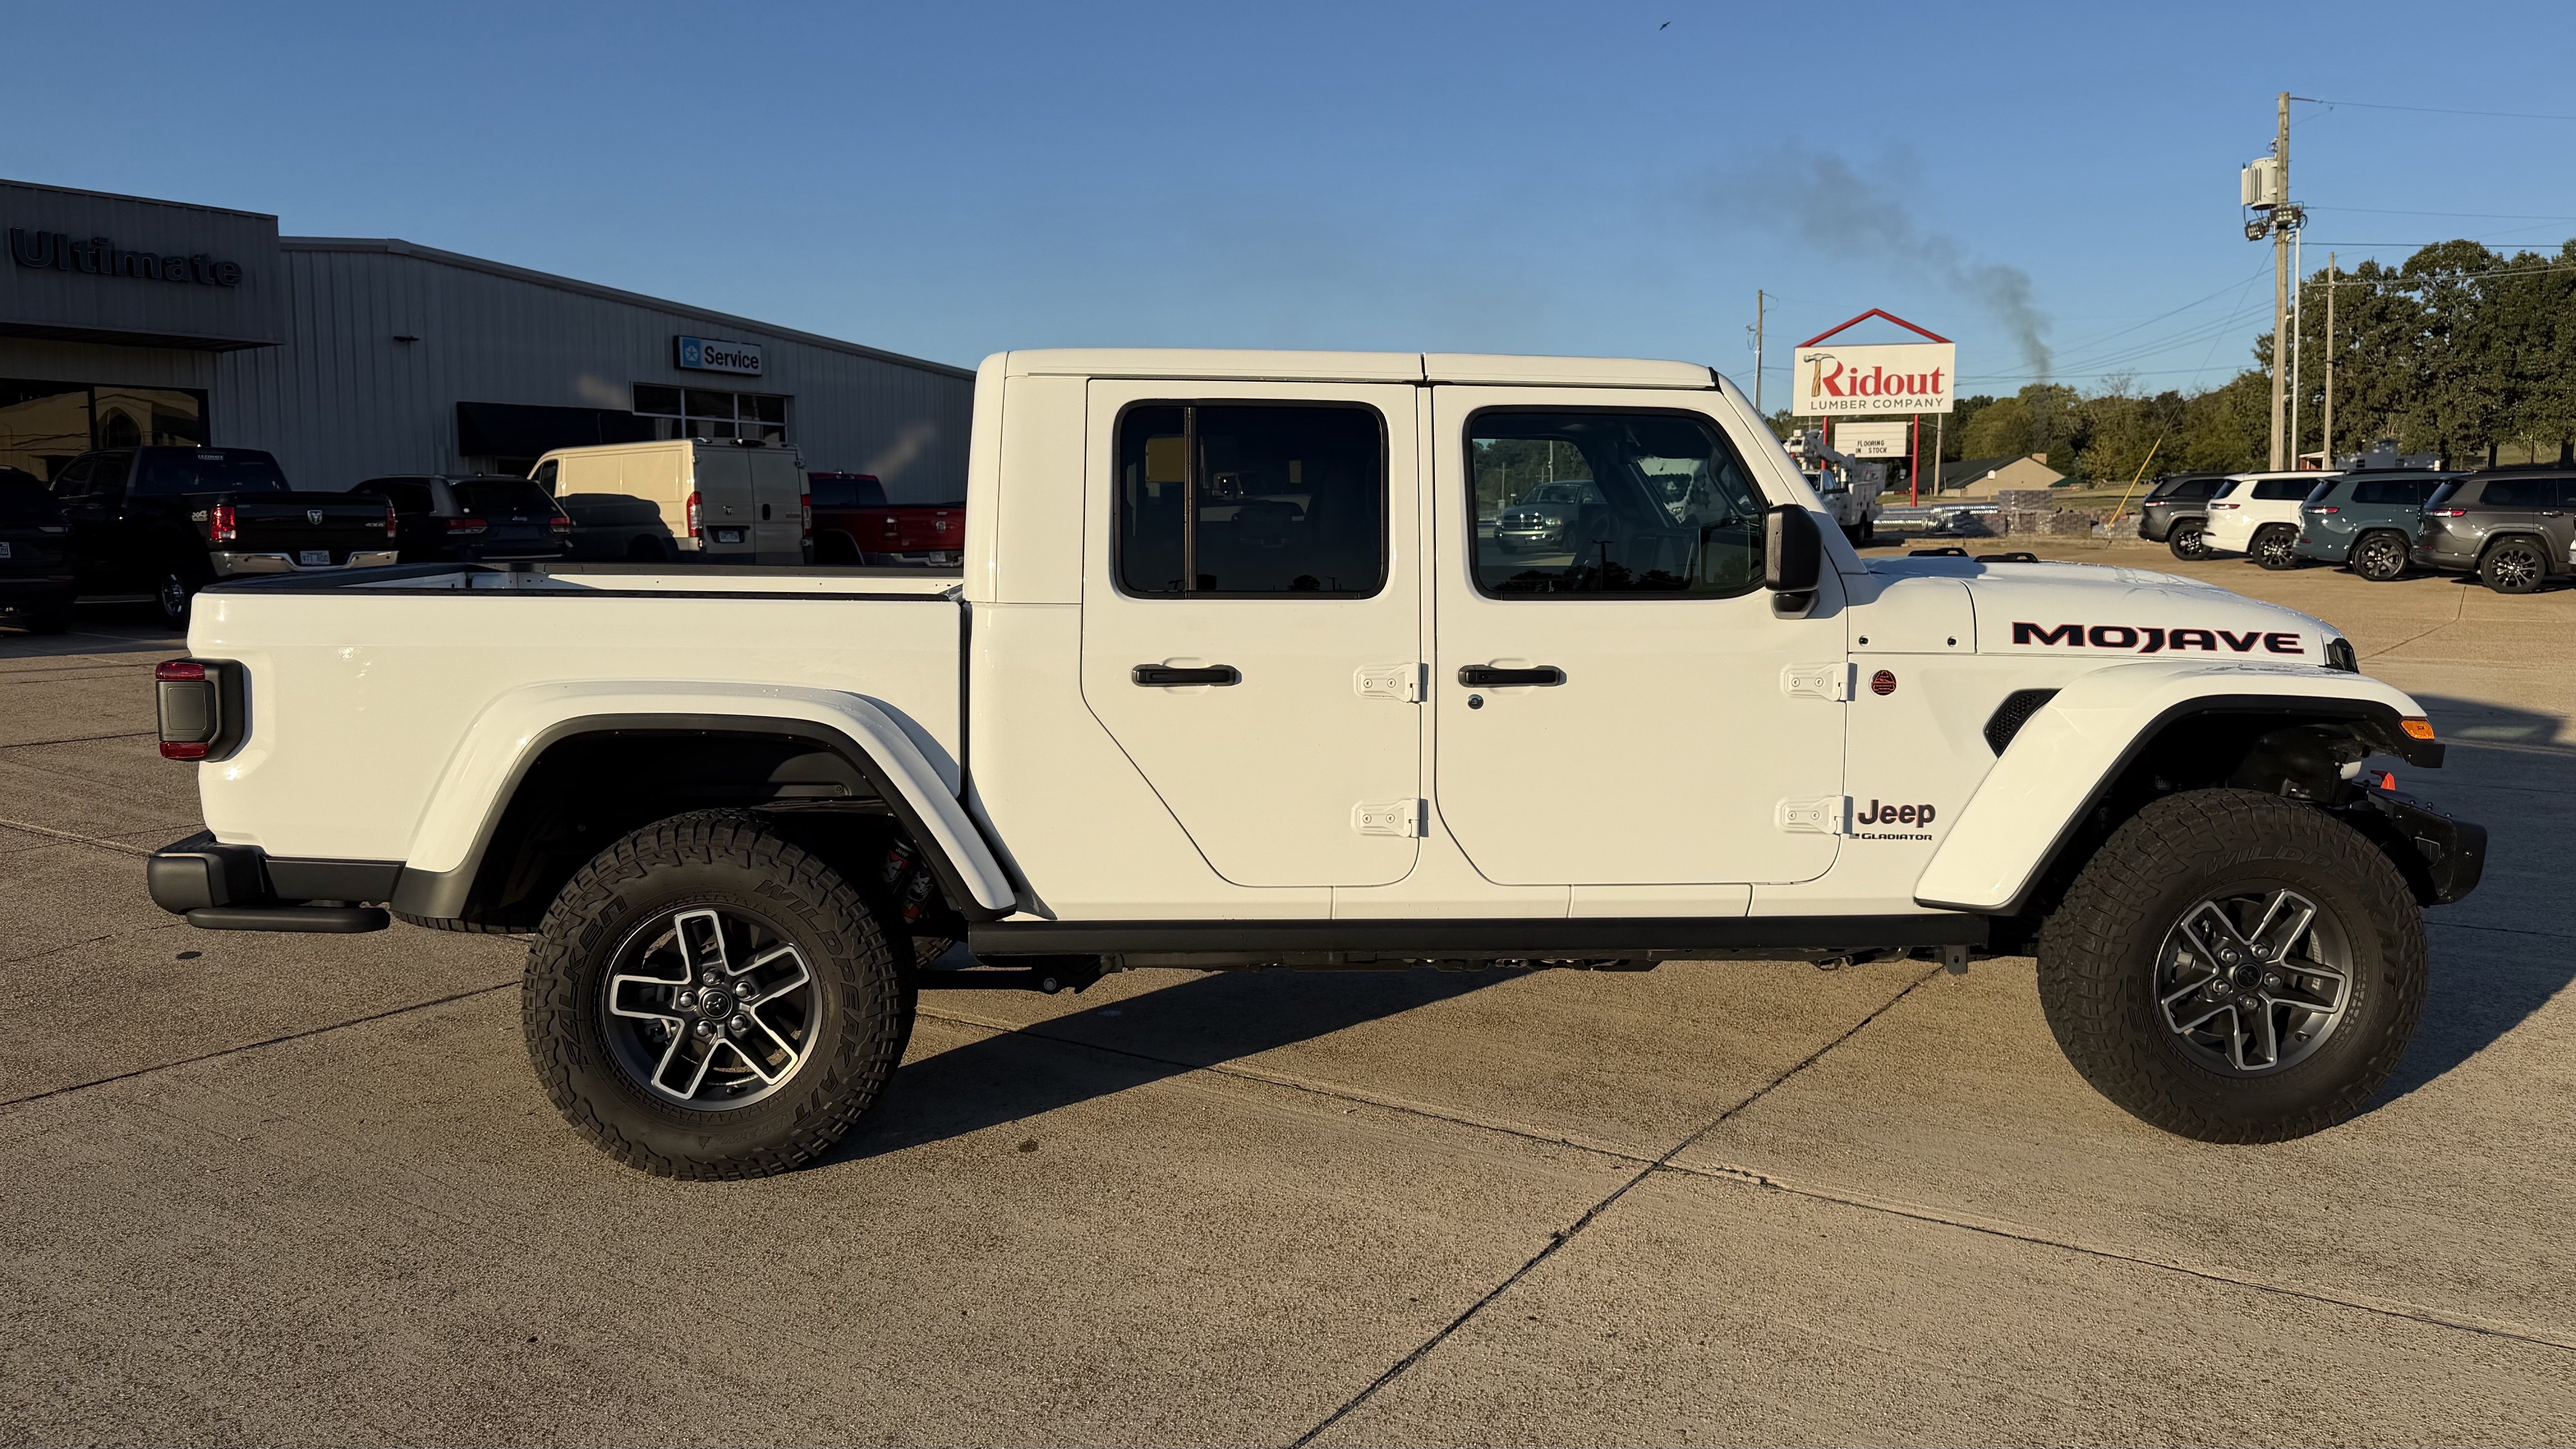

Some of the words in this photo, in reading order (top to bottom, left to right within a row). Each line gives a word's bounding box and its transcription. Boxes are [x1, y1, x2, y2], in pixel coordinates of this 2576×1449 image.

[9, 227, 242, 286] Ultimate
[704, 346, 759, 369] Service
[1803, 353, 1945, 397] Ridout
[1811, 400, 1867, 410] LUMBER
[1873, 398, 1943, 409] COMPANY
[2012, 621, 2305, 655] MOJAVE
[1857, 800, 1936, 828] Jeep
[895, 848, 909, 857] Jeep
[558, 895, 628, 1074] FALKEN
[753, 879, 860, 1067] WILDPEAK
